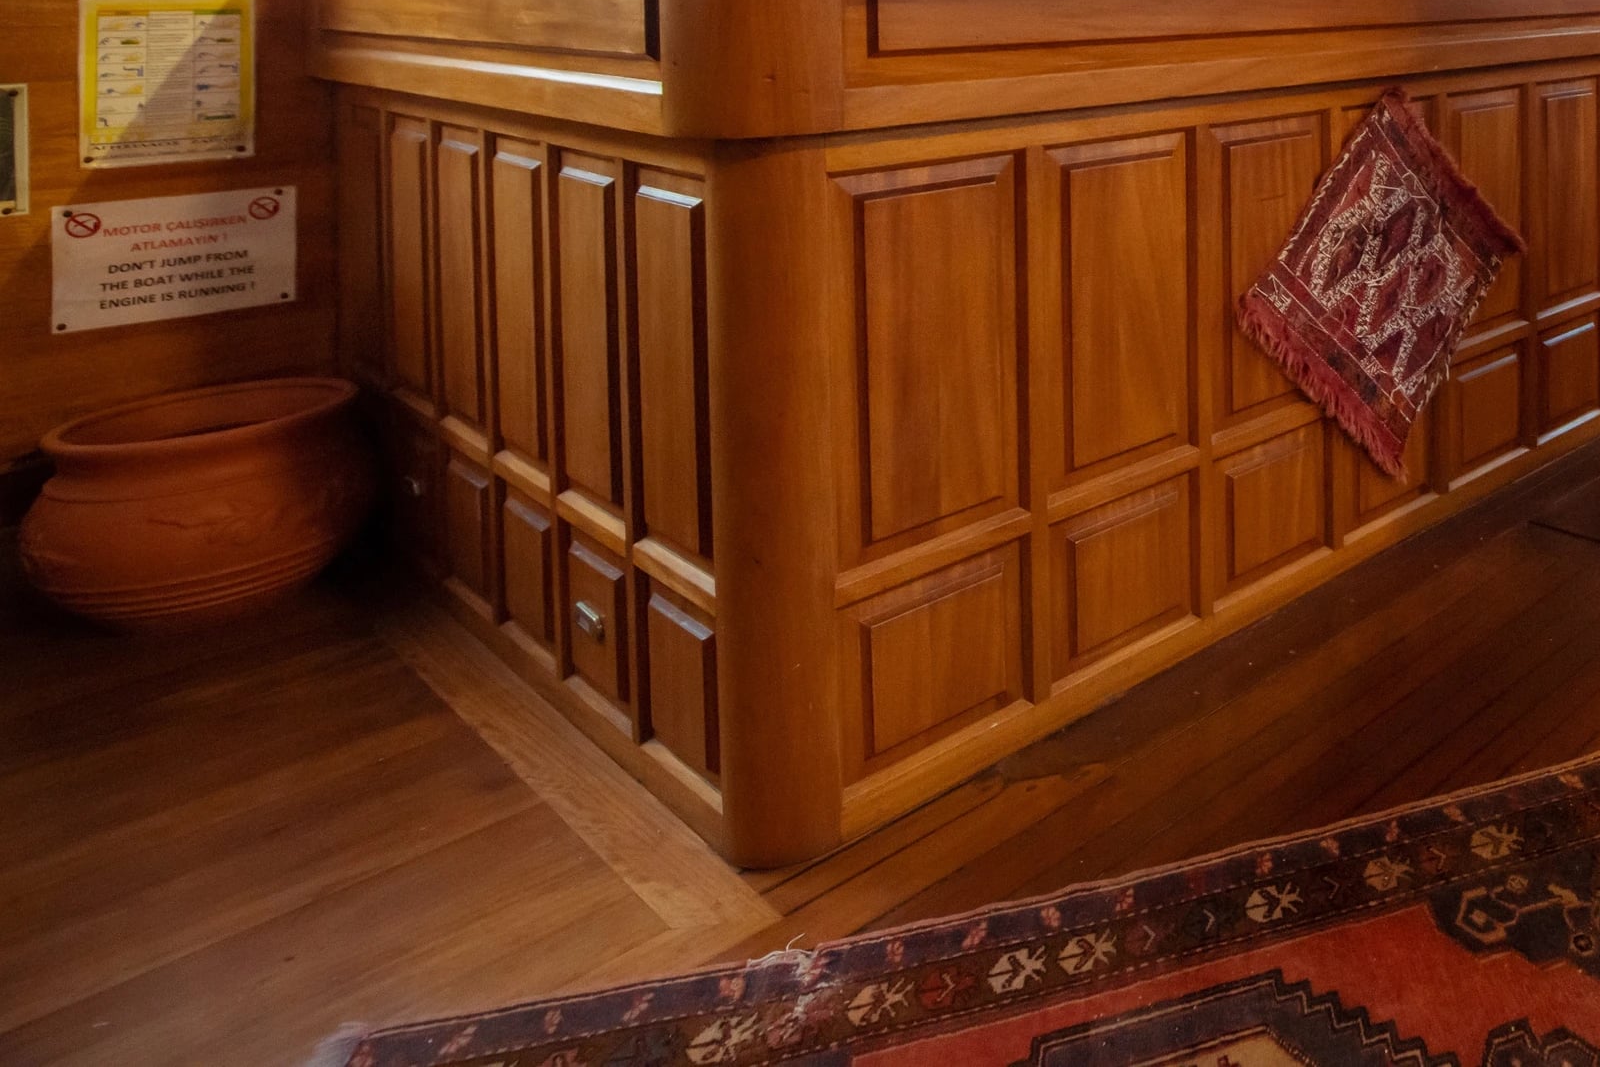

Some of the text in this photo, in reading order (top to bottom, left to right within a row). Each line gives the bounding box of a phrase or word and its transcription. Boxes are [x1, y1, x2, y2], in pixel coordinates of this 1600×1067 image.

[103, 223, 161, 237] MOTOR
[130, 235, 217, 251] ATLAMAYIN
[108, 249, 249, 274] DON'T JUMP FROM
[100, 264, 255, 292] THE BOAT WHILE THE
[99, 294, 156, 310] ENGINE
[160, 290, 175, 302] IS
[179, 284, 246, 298] RUNNING
